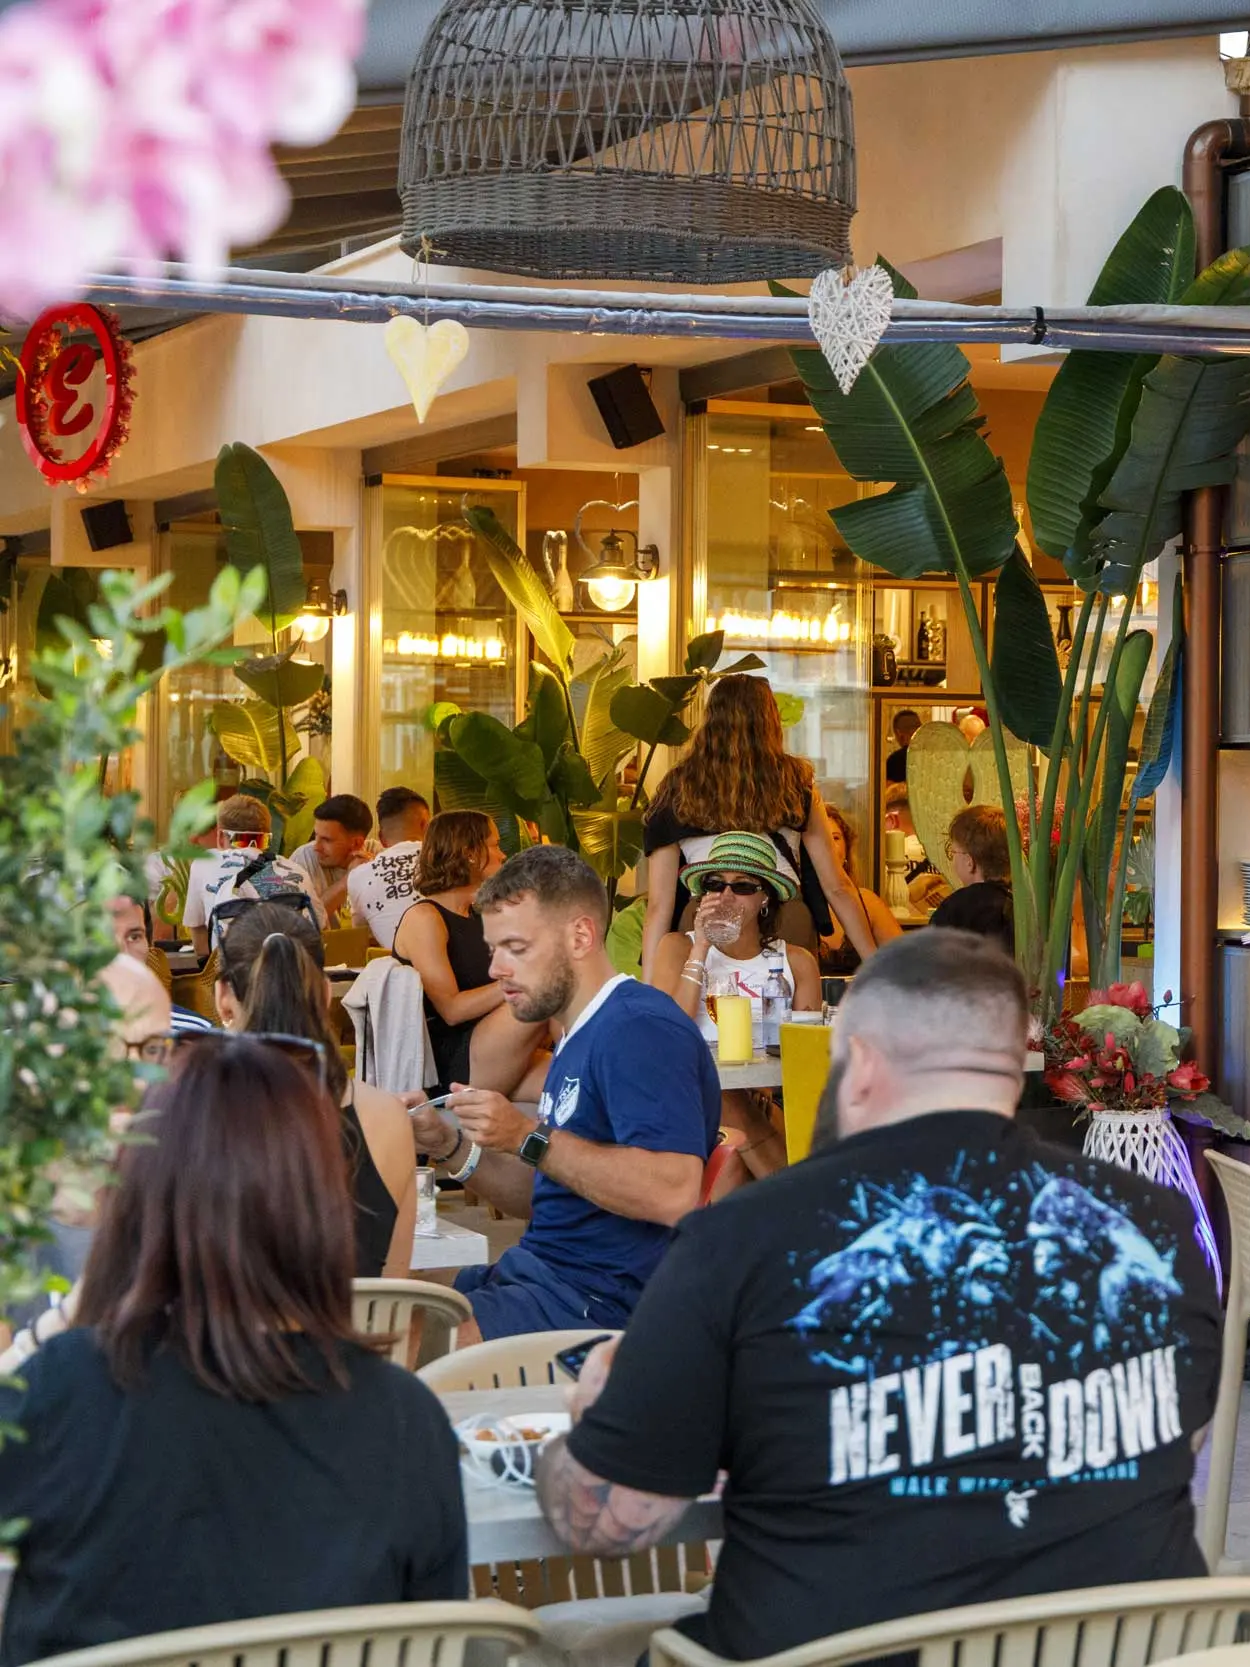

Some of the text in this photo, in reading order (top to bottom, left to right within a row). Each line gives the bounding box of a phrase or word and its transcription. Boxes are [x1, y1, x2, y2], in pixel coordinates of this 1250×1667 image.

[828, 1343, 1183, 1486] NEVER BACK DOWN
[890, 1476, 949, 1496] WALK
